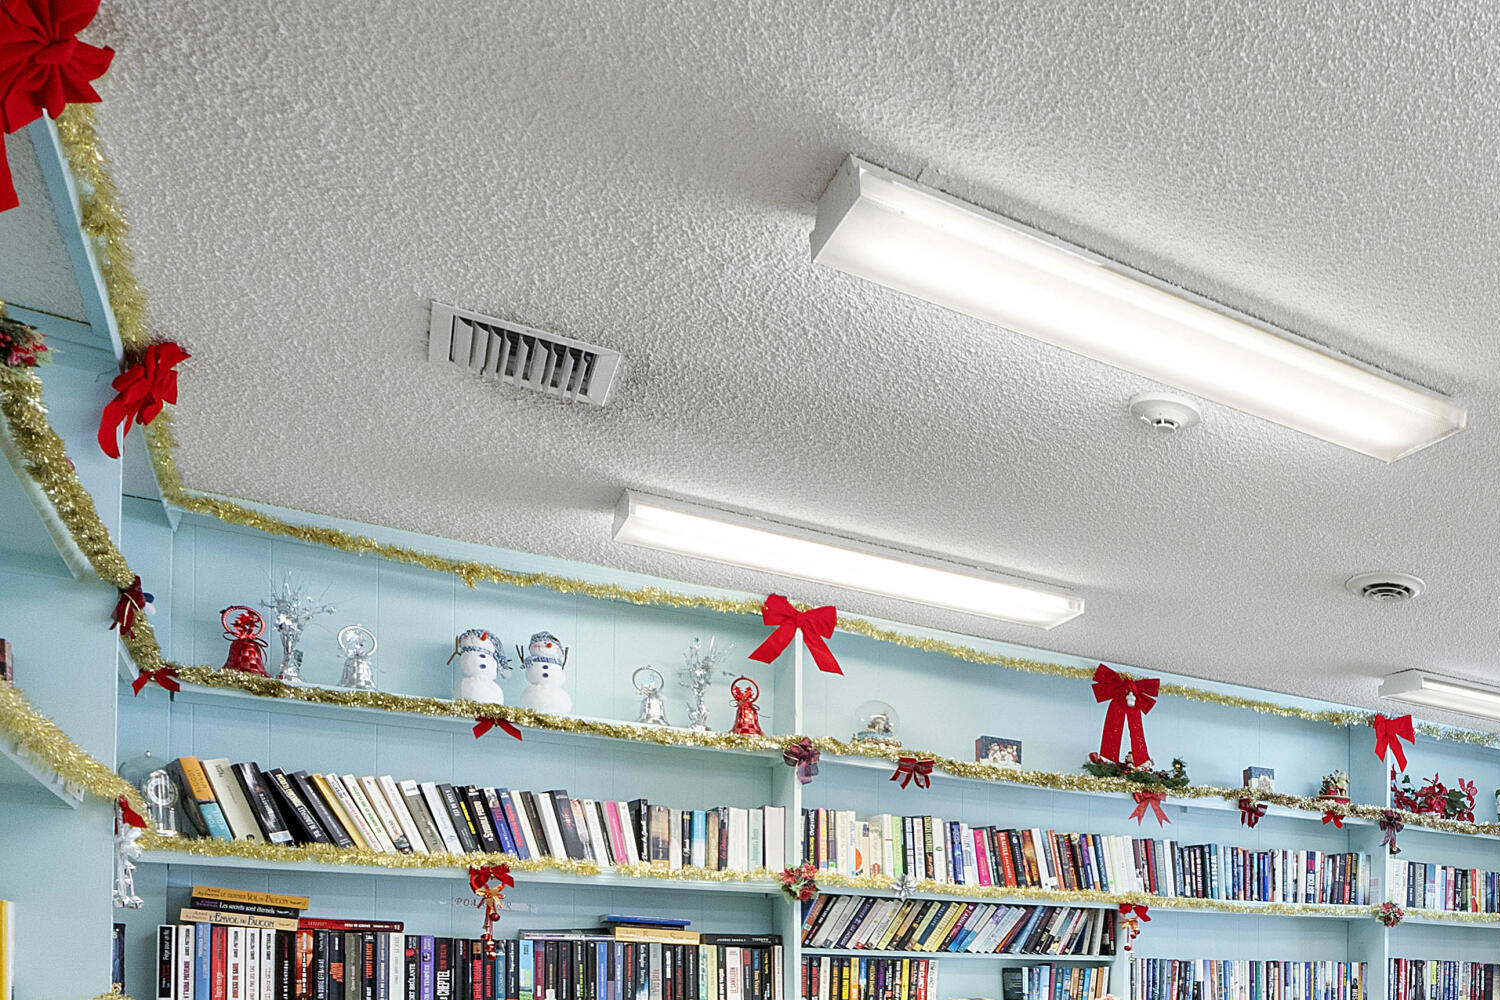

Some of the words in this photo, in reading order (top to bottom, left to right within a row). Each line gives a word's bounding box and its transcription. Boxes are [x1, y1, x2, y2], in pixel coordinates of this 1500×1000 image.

[1000, 834, 1010, 856] FRAGILE
[265, 895, 288, 904] FAUCON
[248, 916, 274, 927] FAUCON
[437, 970, 449, 996] CHEPTEL
